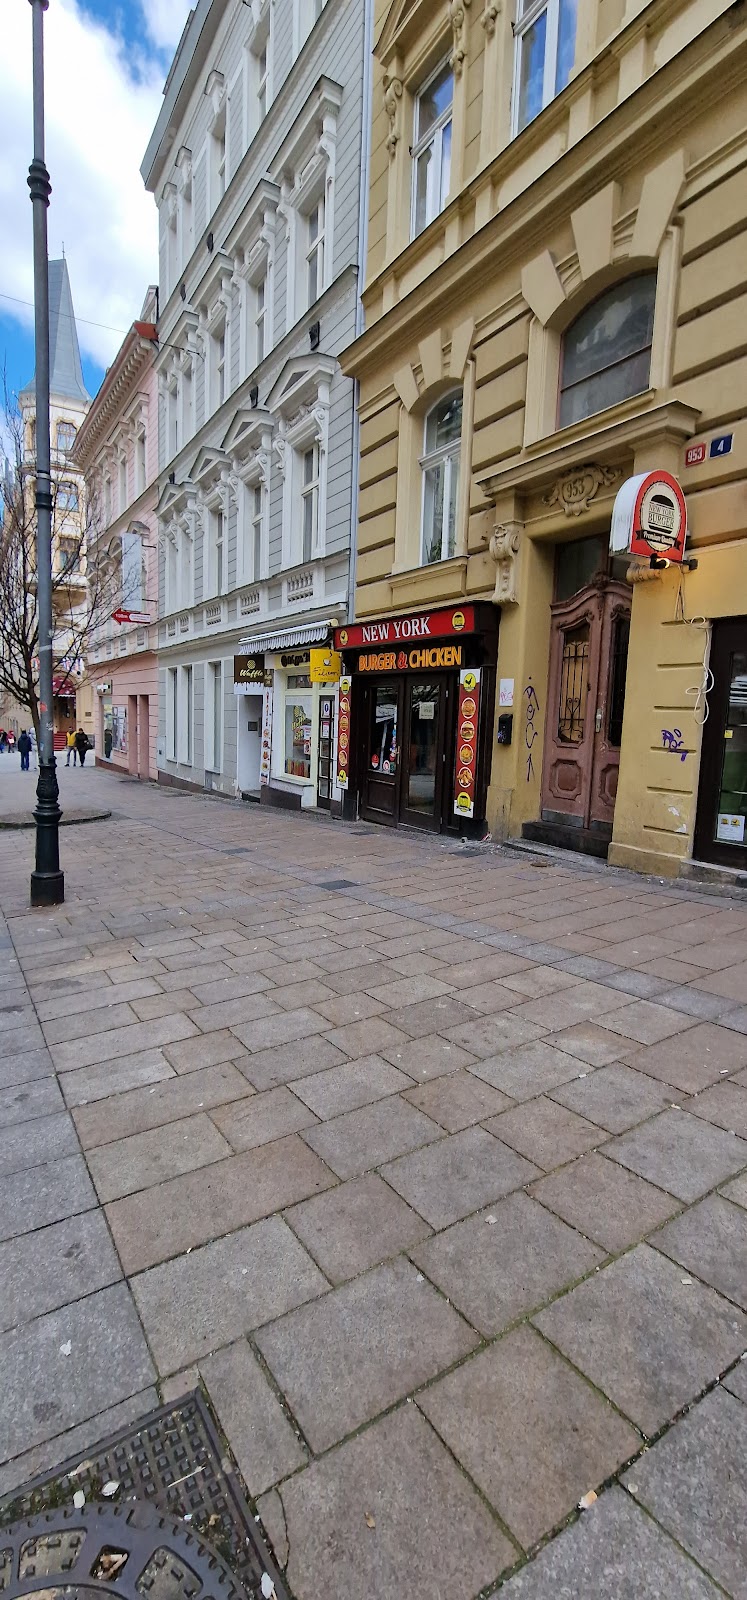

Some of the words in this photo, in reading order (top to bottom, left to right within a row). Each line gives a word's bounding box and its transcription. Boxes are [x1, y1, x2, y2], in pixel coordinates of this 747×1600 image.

[717, 440, 724, 451] 4
[687, 447, 702, 462] 953
[566, 477, 586, 499] 953
[649, 503, 662, 515] NEW
[662, 508, 675, 519] YORK
[648, 512, 675, 528] BURGER
[643, 531, 661, 542] Premium
[361, 623, 390, 643] NEW
[392, 616, 431, 638] YORK
[358, 652, 397, 672] BURGER
[397, 651, 408, 670] &
[408, 645, 462, 669] CHICKEN
[239, 668, 264, 679] Waffle
